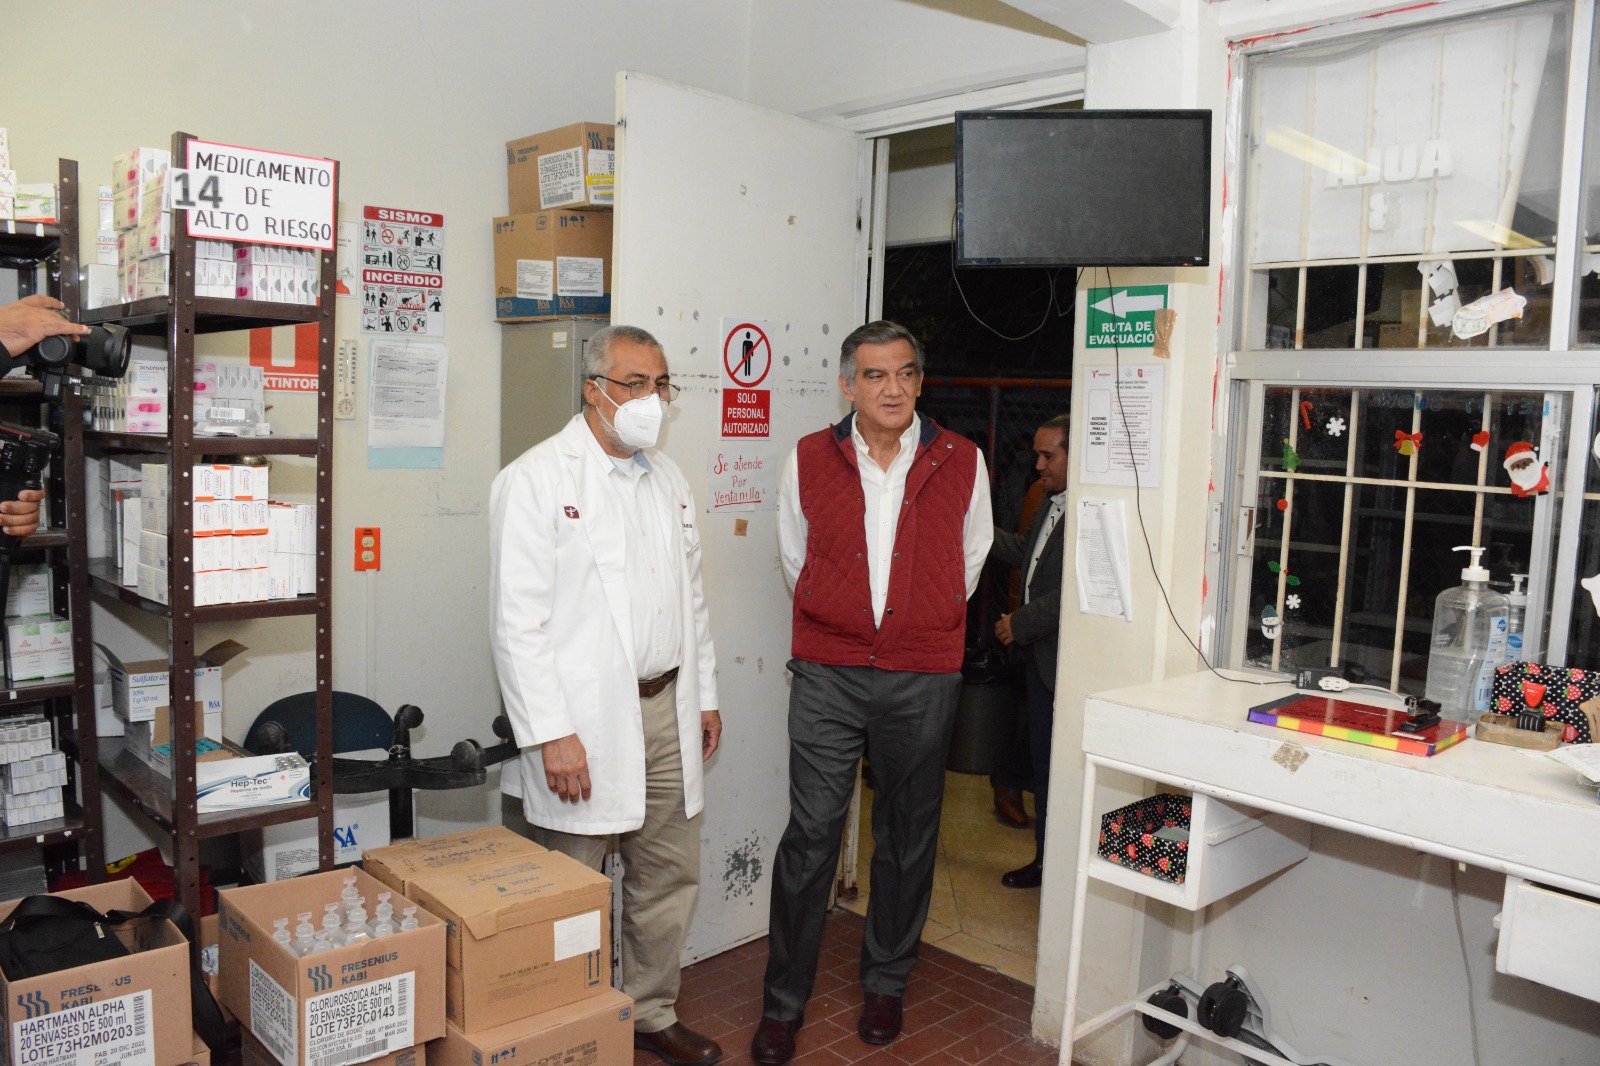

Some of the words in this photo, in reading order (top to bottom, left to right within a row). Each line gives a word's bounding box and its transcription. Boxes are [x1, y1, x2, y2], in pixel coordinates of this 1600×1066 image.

[196, 152, 330, 187] MEDICAMENTO
[174, 172, 223, 208] 14
[245, 186, 272, 208] DE
[378, 209, 432, 224] SISMO
[195, 210, 249, 231] ALTO
[264, 216, 332, 241] RIESGO
[365, 271, 440, 287] INCENDIO
[1102, 322, 1132, 332] RUTA
[1136, 321, 1151, 332] DE
[1090, 332, 1155, 345] EVACUACIÓ
[264, 377, 318, 390] XTINTOR
[737, 393, 757, 404] SOLO
[727, 408, 766, 419] PERSONAL
[723, 423, 769, 434] AUTORIZADO
[714, 453, 728, 474] Se
[734, 455, 763, 471] atiende
[732, 475, 747, 488] Por
[714, 487, 760, 504] Ventanilla
[231, 778, 268, 788] Hep-Tec
[341, 951, 398, 975] FRESENIUS
[341, 971, 367, 986] KABI
[60, 976, 131, 1000] FRESEUS
[369, 982, 392, 998] ALPHA
[20, 1008, 85, 1036] HARTMANN
[88, 1000, 125, 1020] ALPHA
[310, 1014, 319, 1026] 20
[320, 1005, 355, 1023] ENVASES
[358, 1002, 368, 1013] DE
[370, 997, 381, 1009] 500
[384, 994, 392, 1006] ml
[310, 1022, 335, 1038] LOTE
[337, 1005, 395, 1031] 73F2C0143
[20, 1035, 32, 1050] 20
[34, 1025, 80, 1047] ENVASES
[83, 1020, 95, 1034] DE
[98, 1015, 114, 1030] 500
[116, 1012, 127, 1026] ml
[21, 1044, 54, 1064] LOTE
[57, 1024, 133, 1054] 73H2M0203
[48, 1052, 77, 1063] HARTMANN
